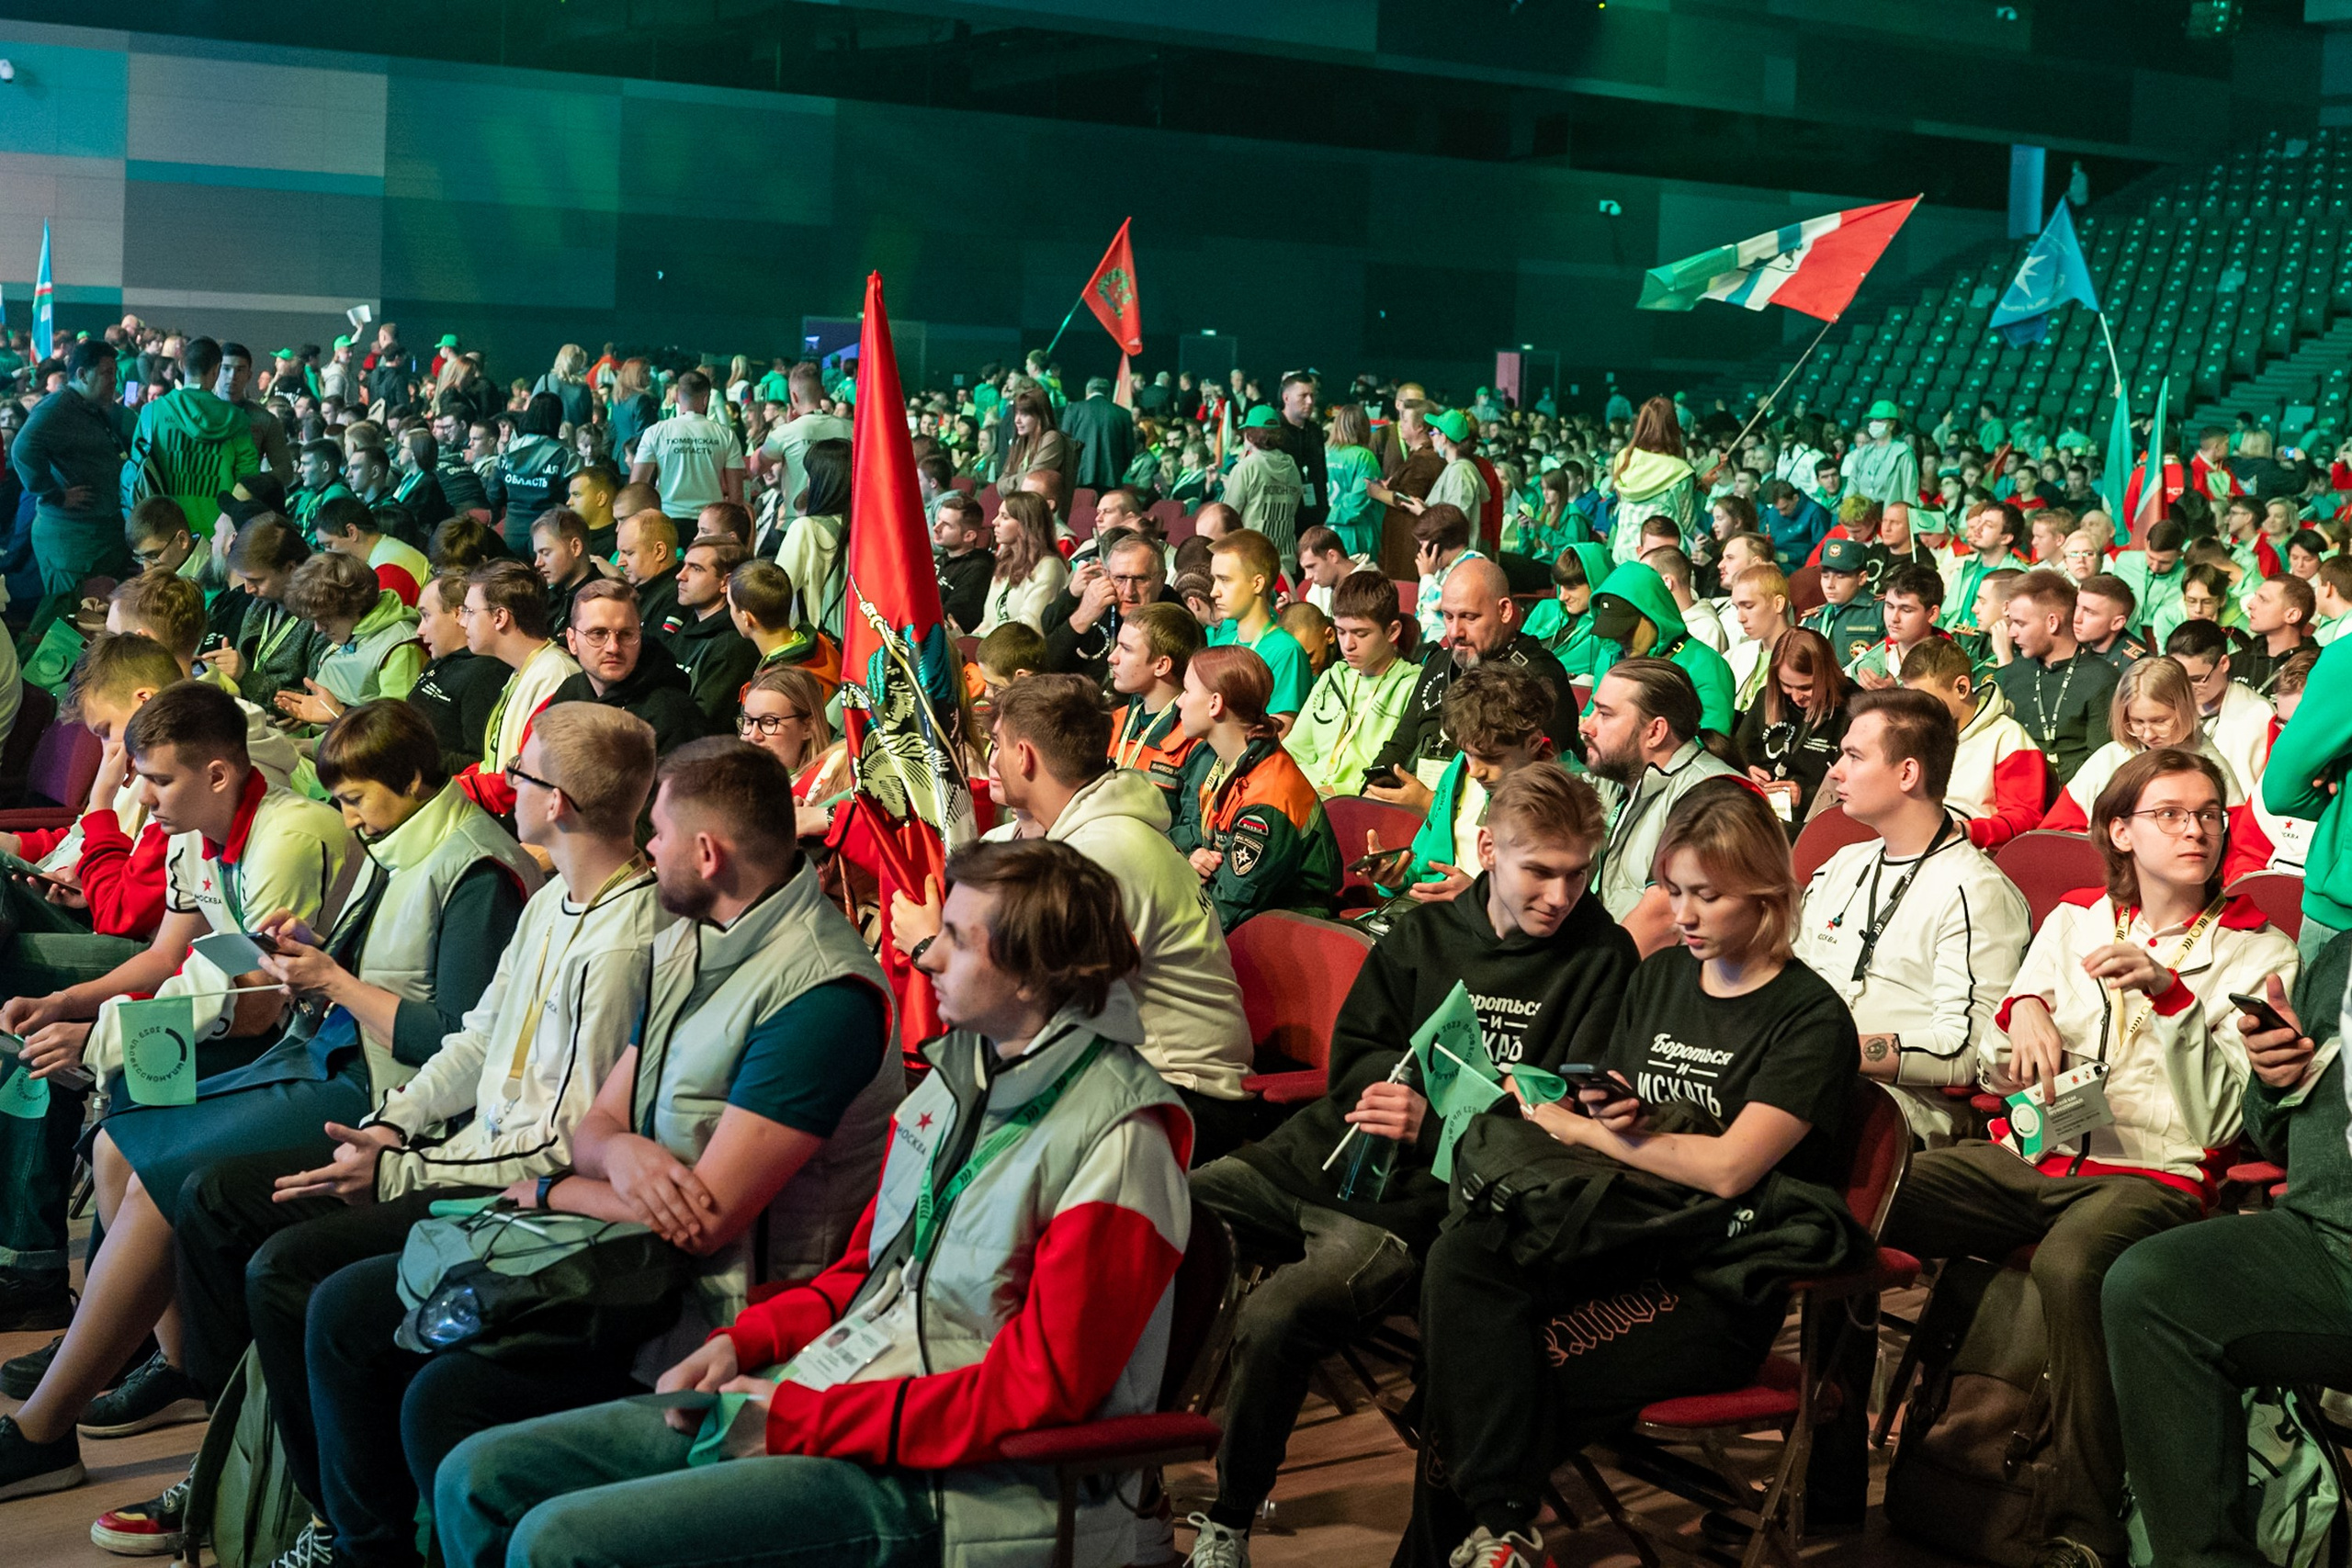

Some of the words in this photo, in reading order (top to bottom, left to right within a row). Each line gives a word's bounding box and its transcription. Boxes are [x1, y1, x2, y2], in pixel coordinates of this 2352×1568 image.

[673, 447, 713, 456] ОБЛАСТЬ
[504, 473, 548, 489] ОБЛАСТЬ
[1650, 1032, 1735, 1066] Бороться
[1637, 1071, 1723, 1119] ИСКАТЬ
